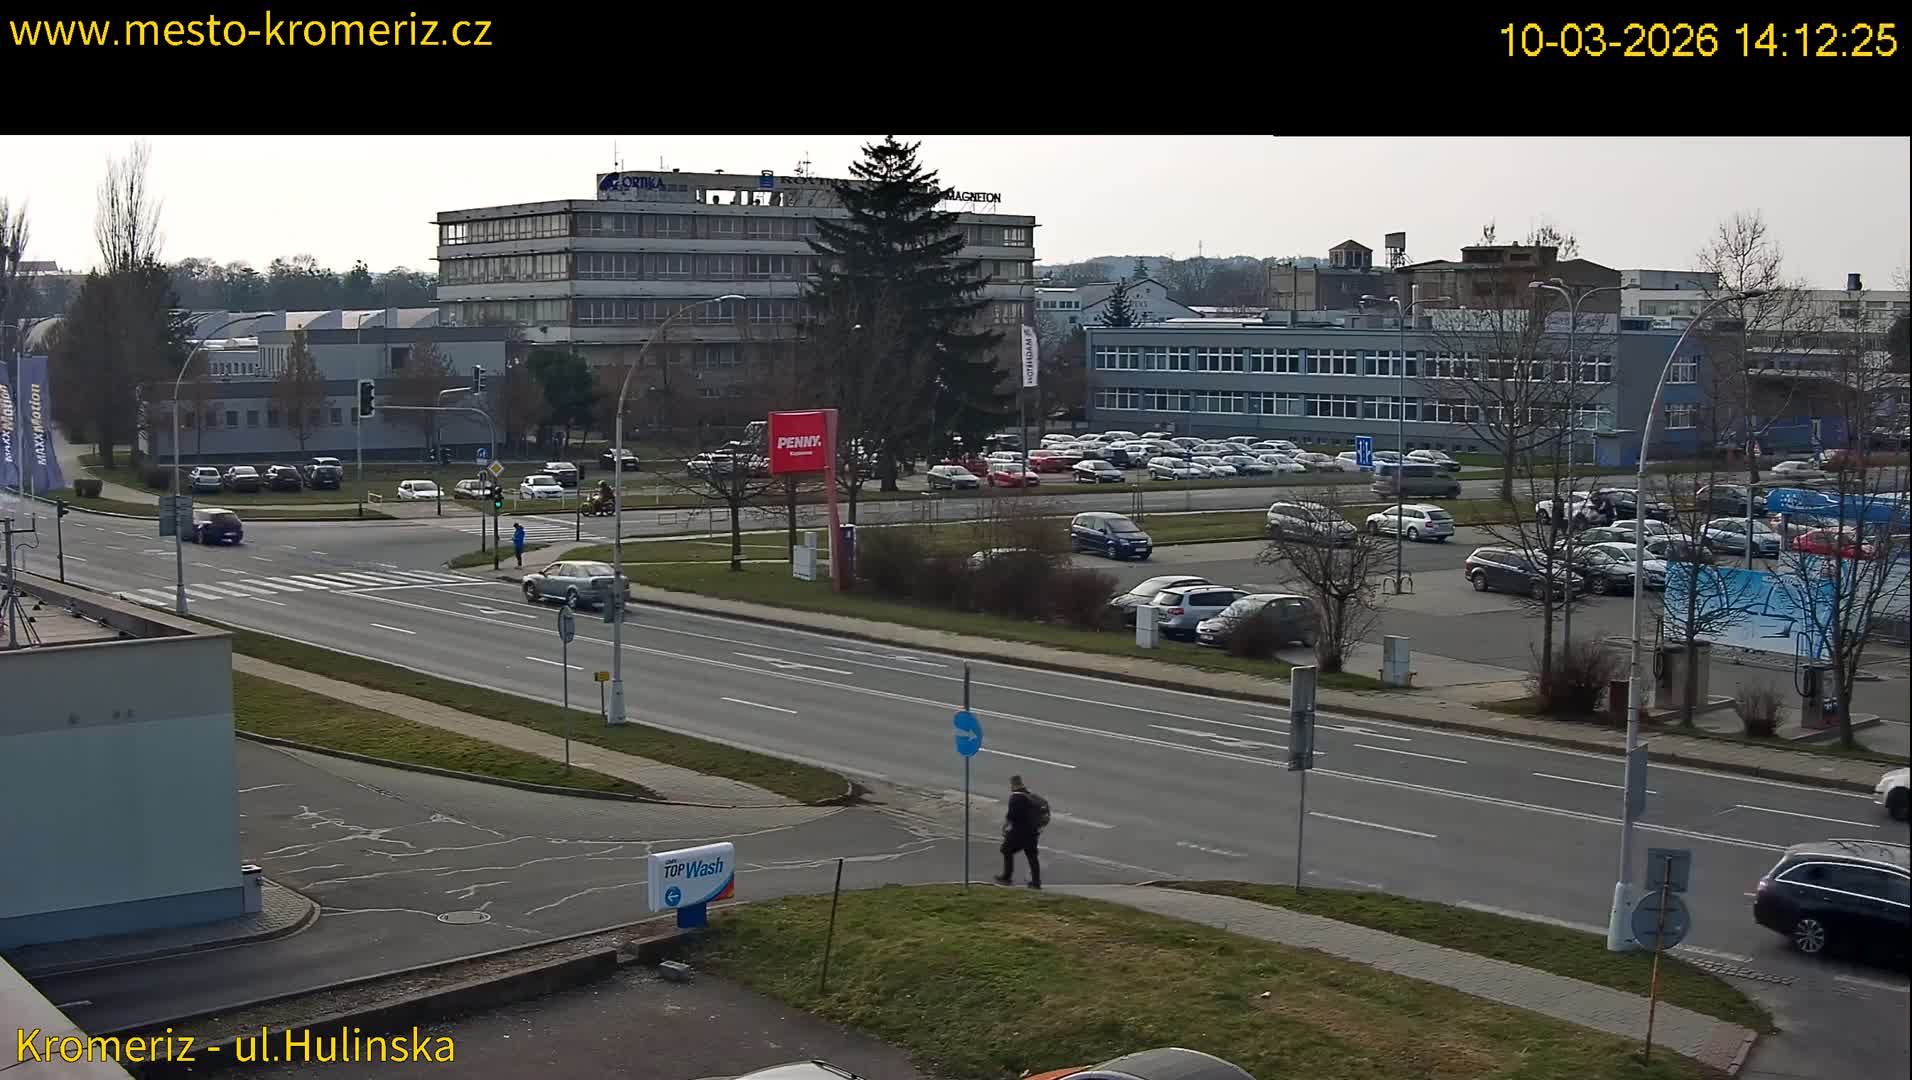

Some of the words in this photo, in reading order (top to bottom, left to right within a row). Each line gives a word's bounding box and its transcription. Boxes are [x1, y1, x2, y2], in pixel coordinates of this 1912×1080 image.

[946, 190, 1001, 203] MAGNETON
[664, 863, 685, 878] TOP
[686, 857, 723, 878] Wash
